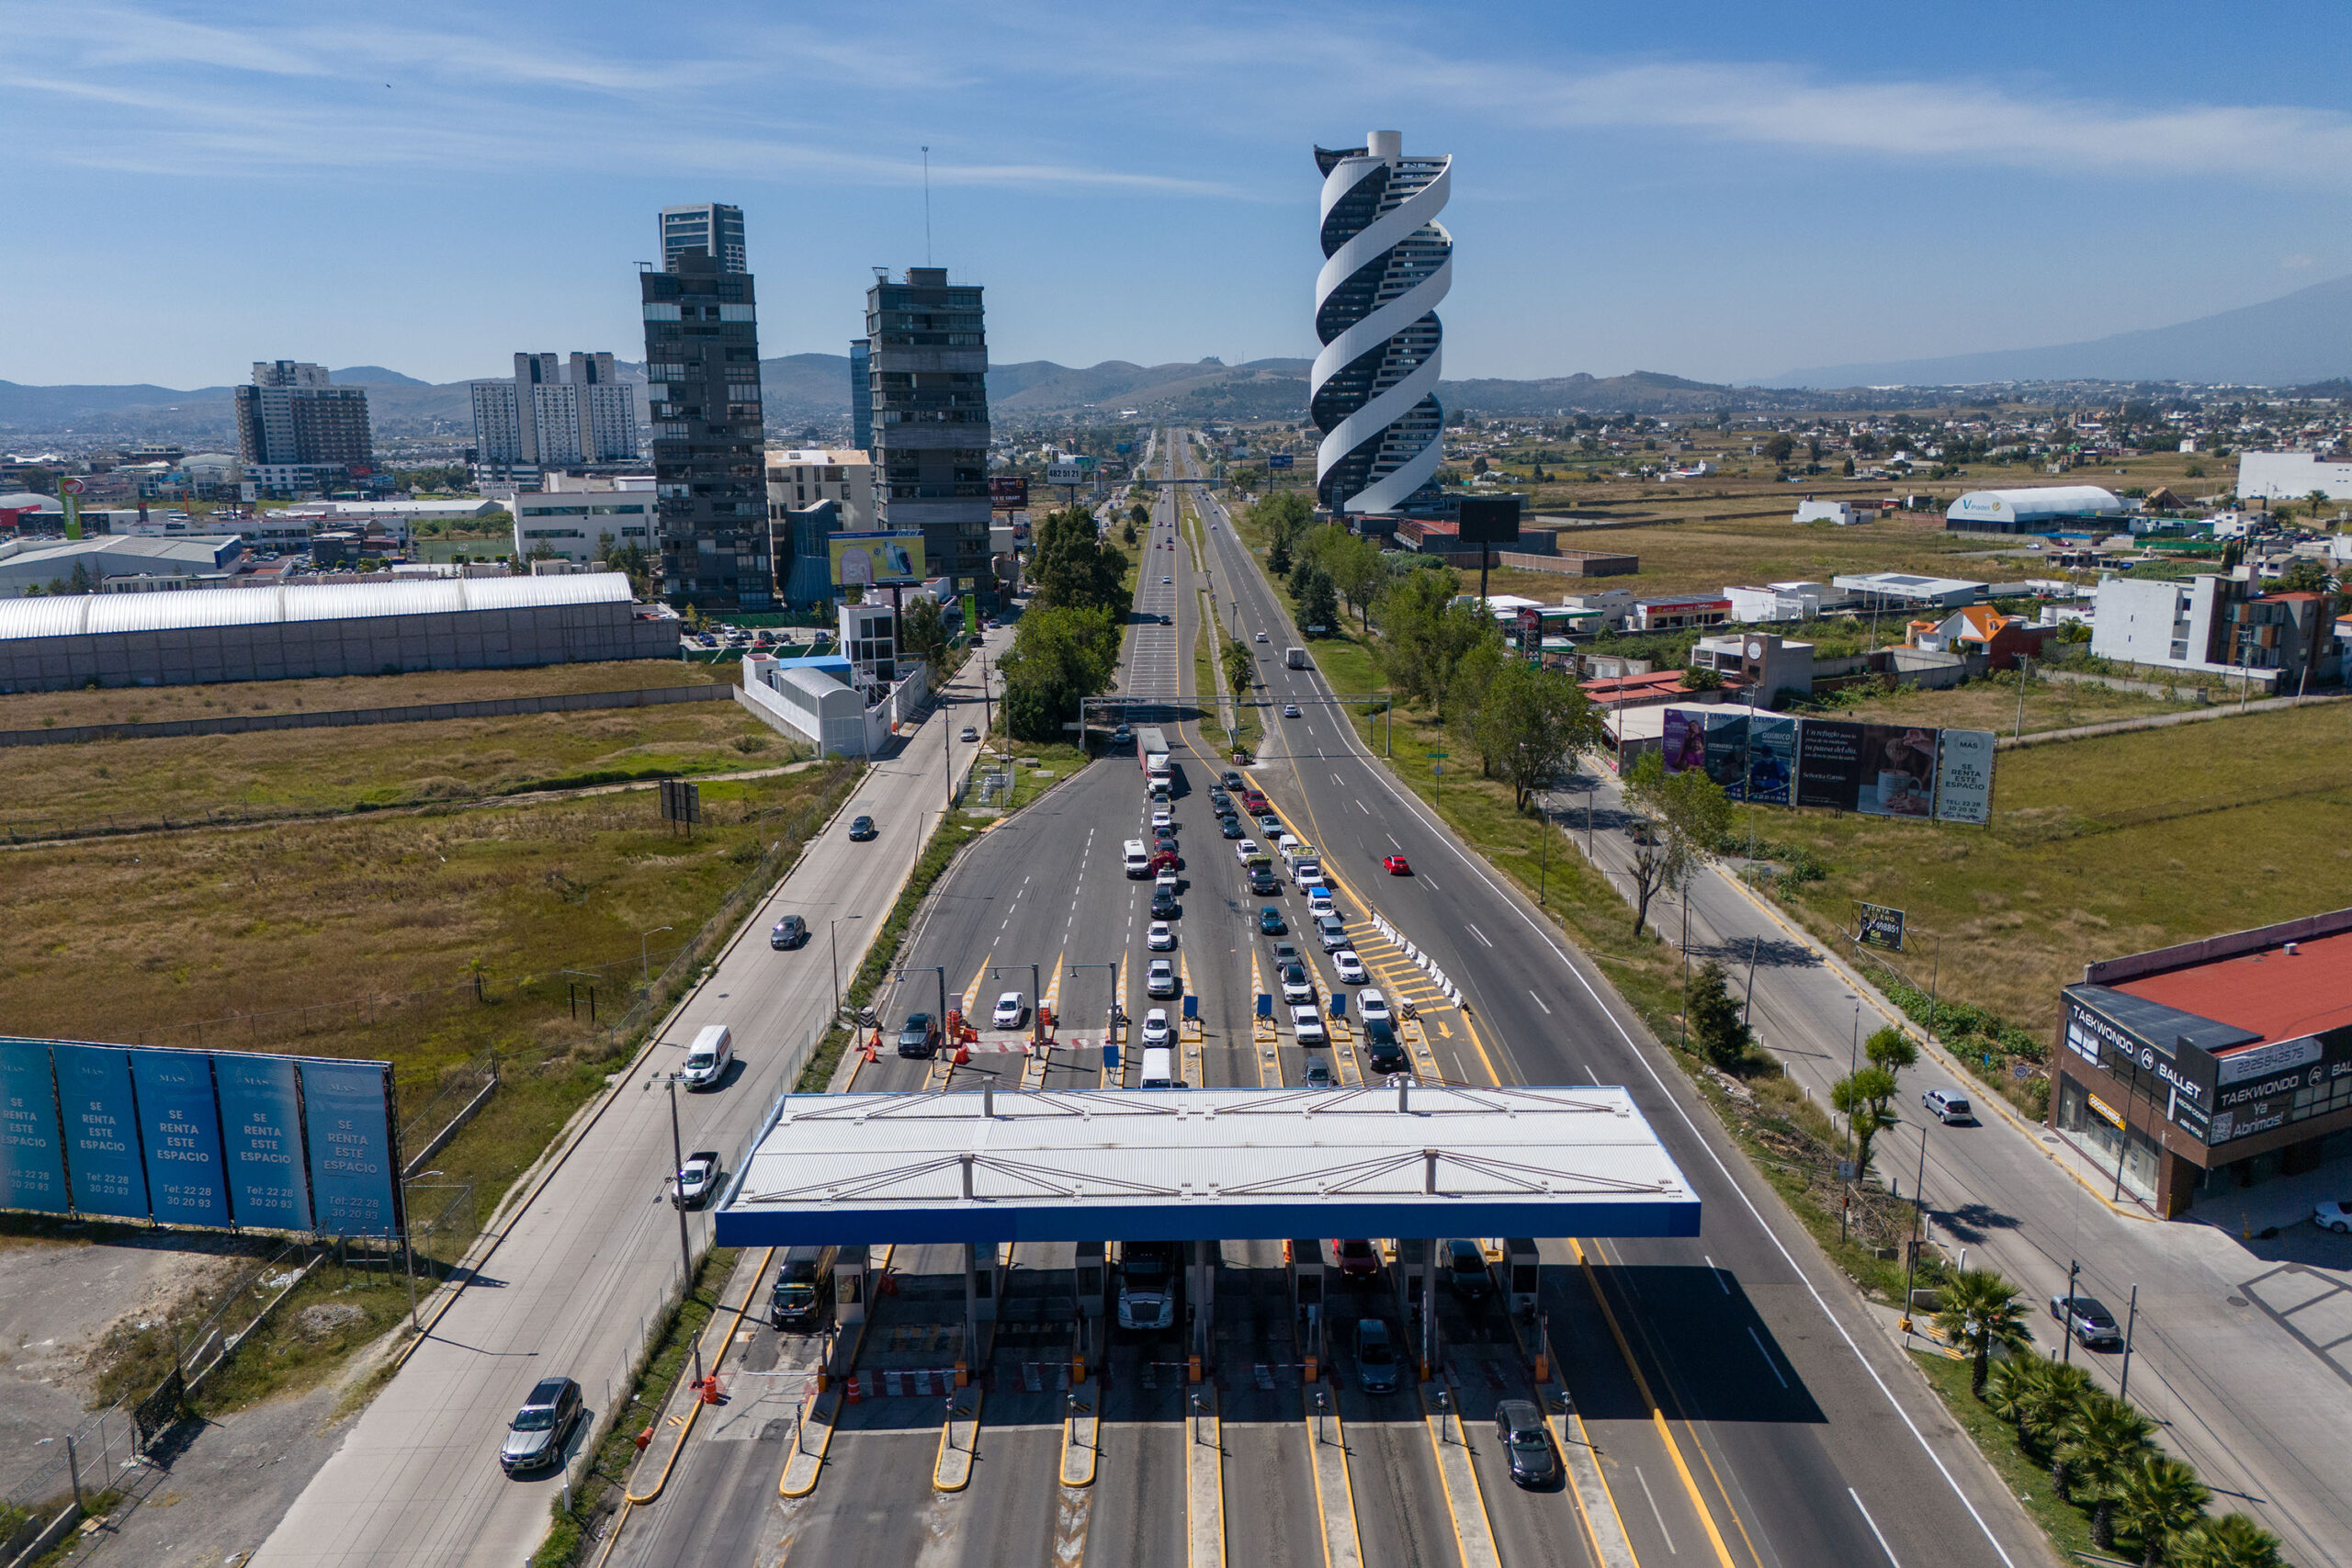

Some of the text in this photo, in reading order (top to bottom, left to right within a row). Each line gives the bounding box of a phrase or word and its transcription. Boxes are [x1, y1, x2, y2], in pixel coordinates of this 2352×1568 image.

[1963, 499, 1972, 510] V
[1951, 769, 1981, 777] RENTA
[1945, 781, 1985, 790] ESPACIO
[2073, 1005, 2134, 1054] TAEKWONDO
[2159, 1063, 2202, 1099] BALLET
[2221, 1075, 2299, 1106] TAEKWONDO
[11, 1098, 23, 1107] SE
[90, 1102, 102, 1111] SE
[2253, 1102, 2268, 1115] Ya
[2, 1110, 37, 1121] RENTA
[82, 1114, 116, 1125] RENTA
[169, 1110, 183, 1120] SE
[253, 1113, 267, 1123] SE
[10, 1123, 34, 1134] ESTE
[159, 1123, 199, 1134] RENTA
[338, 1120, 352, 1130] SE
[2233, 1111, 2284, 1138] Abrimos!
[89, 1127, 113, 1138] ESTE
[244, 1126, 282, 1137] RENTA
[1, 1136, 46, 1147] ESPACIO
[167, 1137, 195, 1148] ESTE
[251, 1139, 278, 1150] ESTE
[328, 1133, 368, 1146] RENTA
[80, 1140, 125, 1151] ESPACIO
[157, 1150, 209, 1162] ESPACIO
[240, 1152, 291, 1163] ESPACIO
[335, 1148, 363, 1158] ESTE
[323, 1160, 378, 1174] ESPACIO
[25, 1170, 36, 1179] 22
[38, 1171, 49, 1181] 28
[104, 1174, 116, 1183] 22
[118, 1175, 129, 1184] 28
[24, 1181, 35, 1190] 20
[90, 1184, 129, 1195] 30 20 93
[163, 1184, 212, 1196] Tel: 22 28
[267, 1187, 279, 1196] 22
[282, 1188, 293, 1197] 28
[167, 1196, 211, 1208] 30 20 93
[250, 1197, 292, 1208] 30 20 93
[350, 1197, 363, 1206] 22
[366, 1199, 379, 1208] 28
[332, 1208, 378, 1220] 30 20 93
